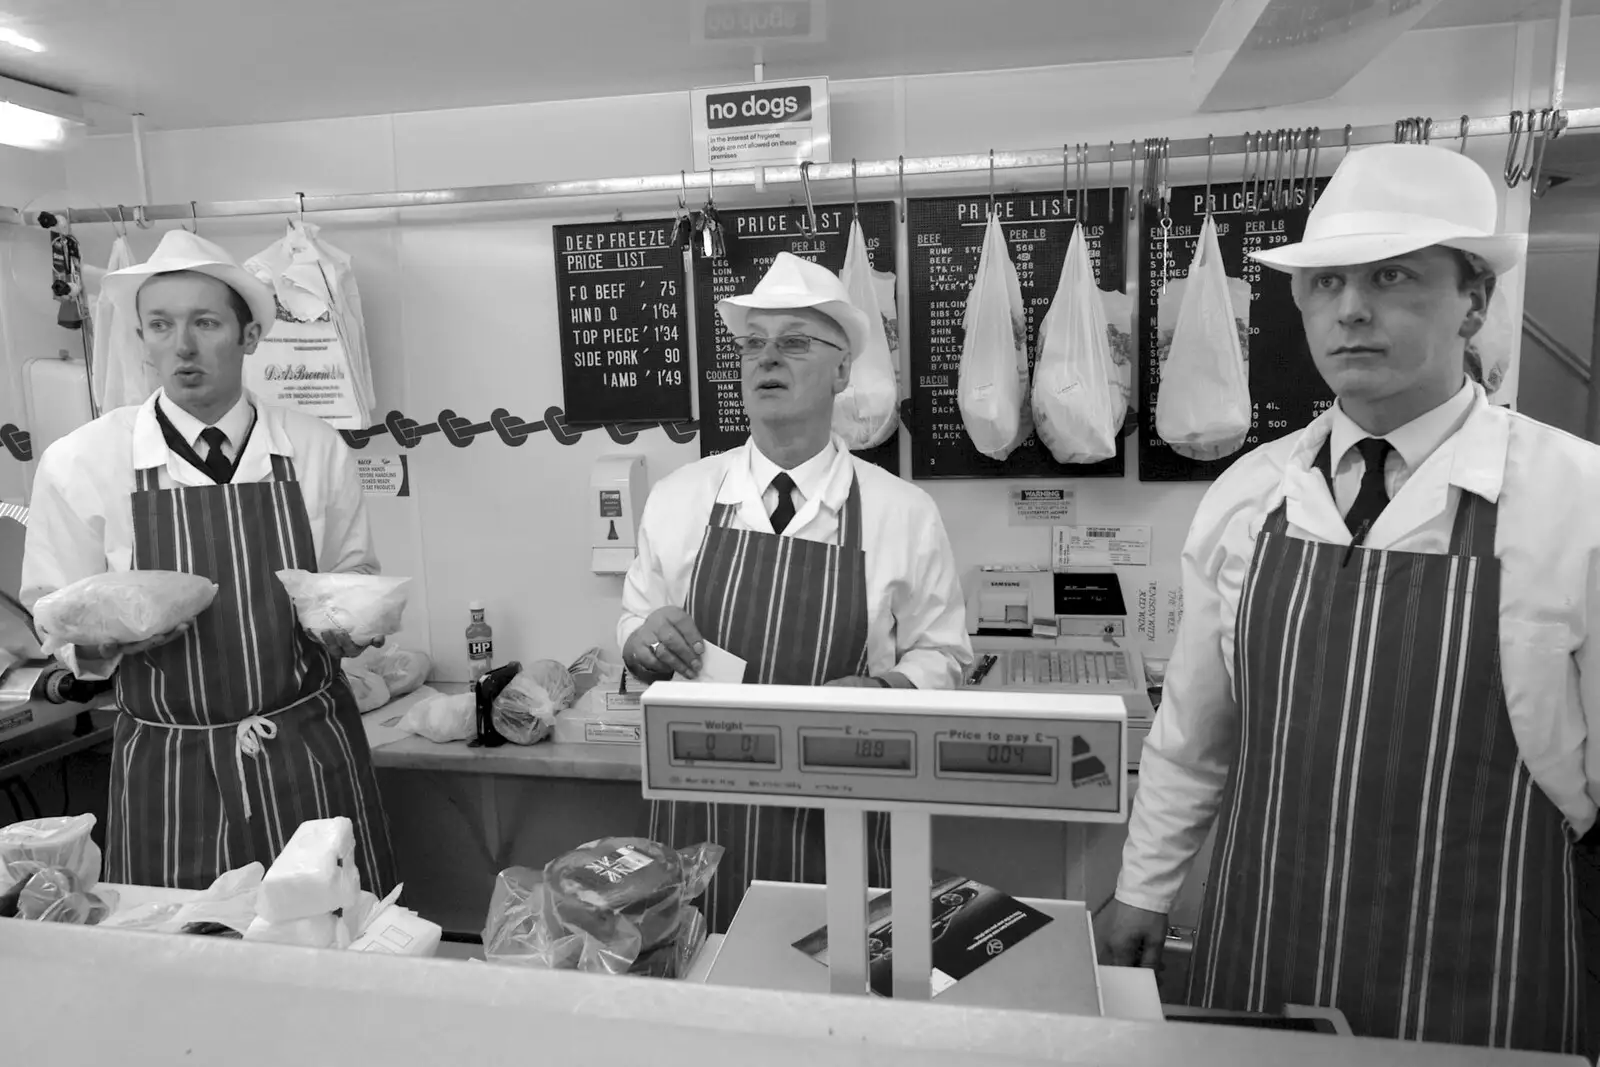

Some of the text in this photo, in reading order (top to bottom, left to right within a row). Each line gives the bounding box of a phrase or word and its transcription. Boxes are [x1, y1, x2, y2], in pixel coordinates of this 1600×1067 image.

[709, 95, 798, 120] no dogs
[727, 134, 749, 142] interest
[757, 132, 780, 141] hygiene
[711, 144, 726, 152] dogs
[710, 152, 737, 161] premises
[958, 198, 1074, 220] PRICE LIST
[737, 212, 842, 233] PRICE LST
[1246, 221, 1265, 231] PER
[1272, 220, 1285, 230] LB
[917, 234, 941, 243] BEEF
[1010, 229, 1028, 239] PER
[1034, 228, 1046, 238] LB
[791, 241, 809, 251] PER
[1242, 237, 1262, 245] 379
[1016, 244, 1034, 252] 568
[1150, 251, 1173, 259] LON
[567, 252, 646, 270] PRICE LIST
[712, 268, 732, 276] LOIN
[713, 276, 746, 284] BREAST
[596, 283, 626, 300] BEEF
[660, 281, 676, 296] 75
[930, 301, 966, 309] SIRLOIN
[571, 307, 602, 324] HIND
[930, 310, 950, 318] RIBS
[931, 318, 962, 326] BRISKE
[573, 329, 598, 345] TOP
[604, 328, 639, 344] PIECE
[574, 348, 680, 367] SIDE PORK 90
[706, 370, 739, 380] COOKED
[920, 375, 949, 385] BACON
[718, 408, 740, 416] CORN
[932, 406, 954, 414] BACK
[1268, 420, 1287, 428] 500
[932, 432, 961, 440] BLACK
[1024, 490, 1060, 498] WARNING
[472, 642, 490, 654] HP
[705, 720, 743, 731] Weight
[950, 730, 981, 740] Price
[988, 732, 999, 741] to
[1006, 734, 1028, 744] pay
